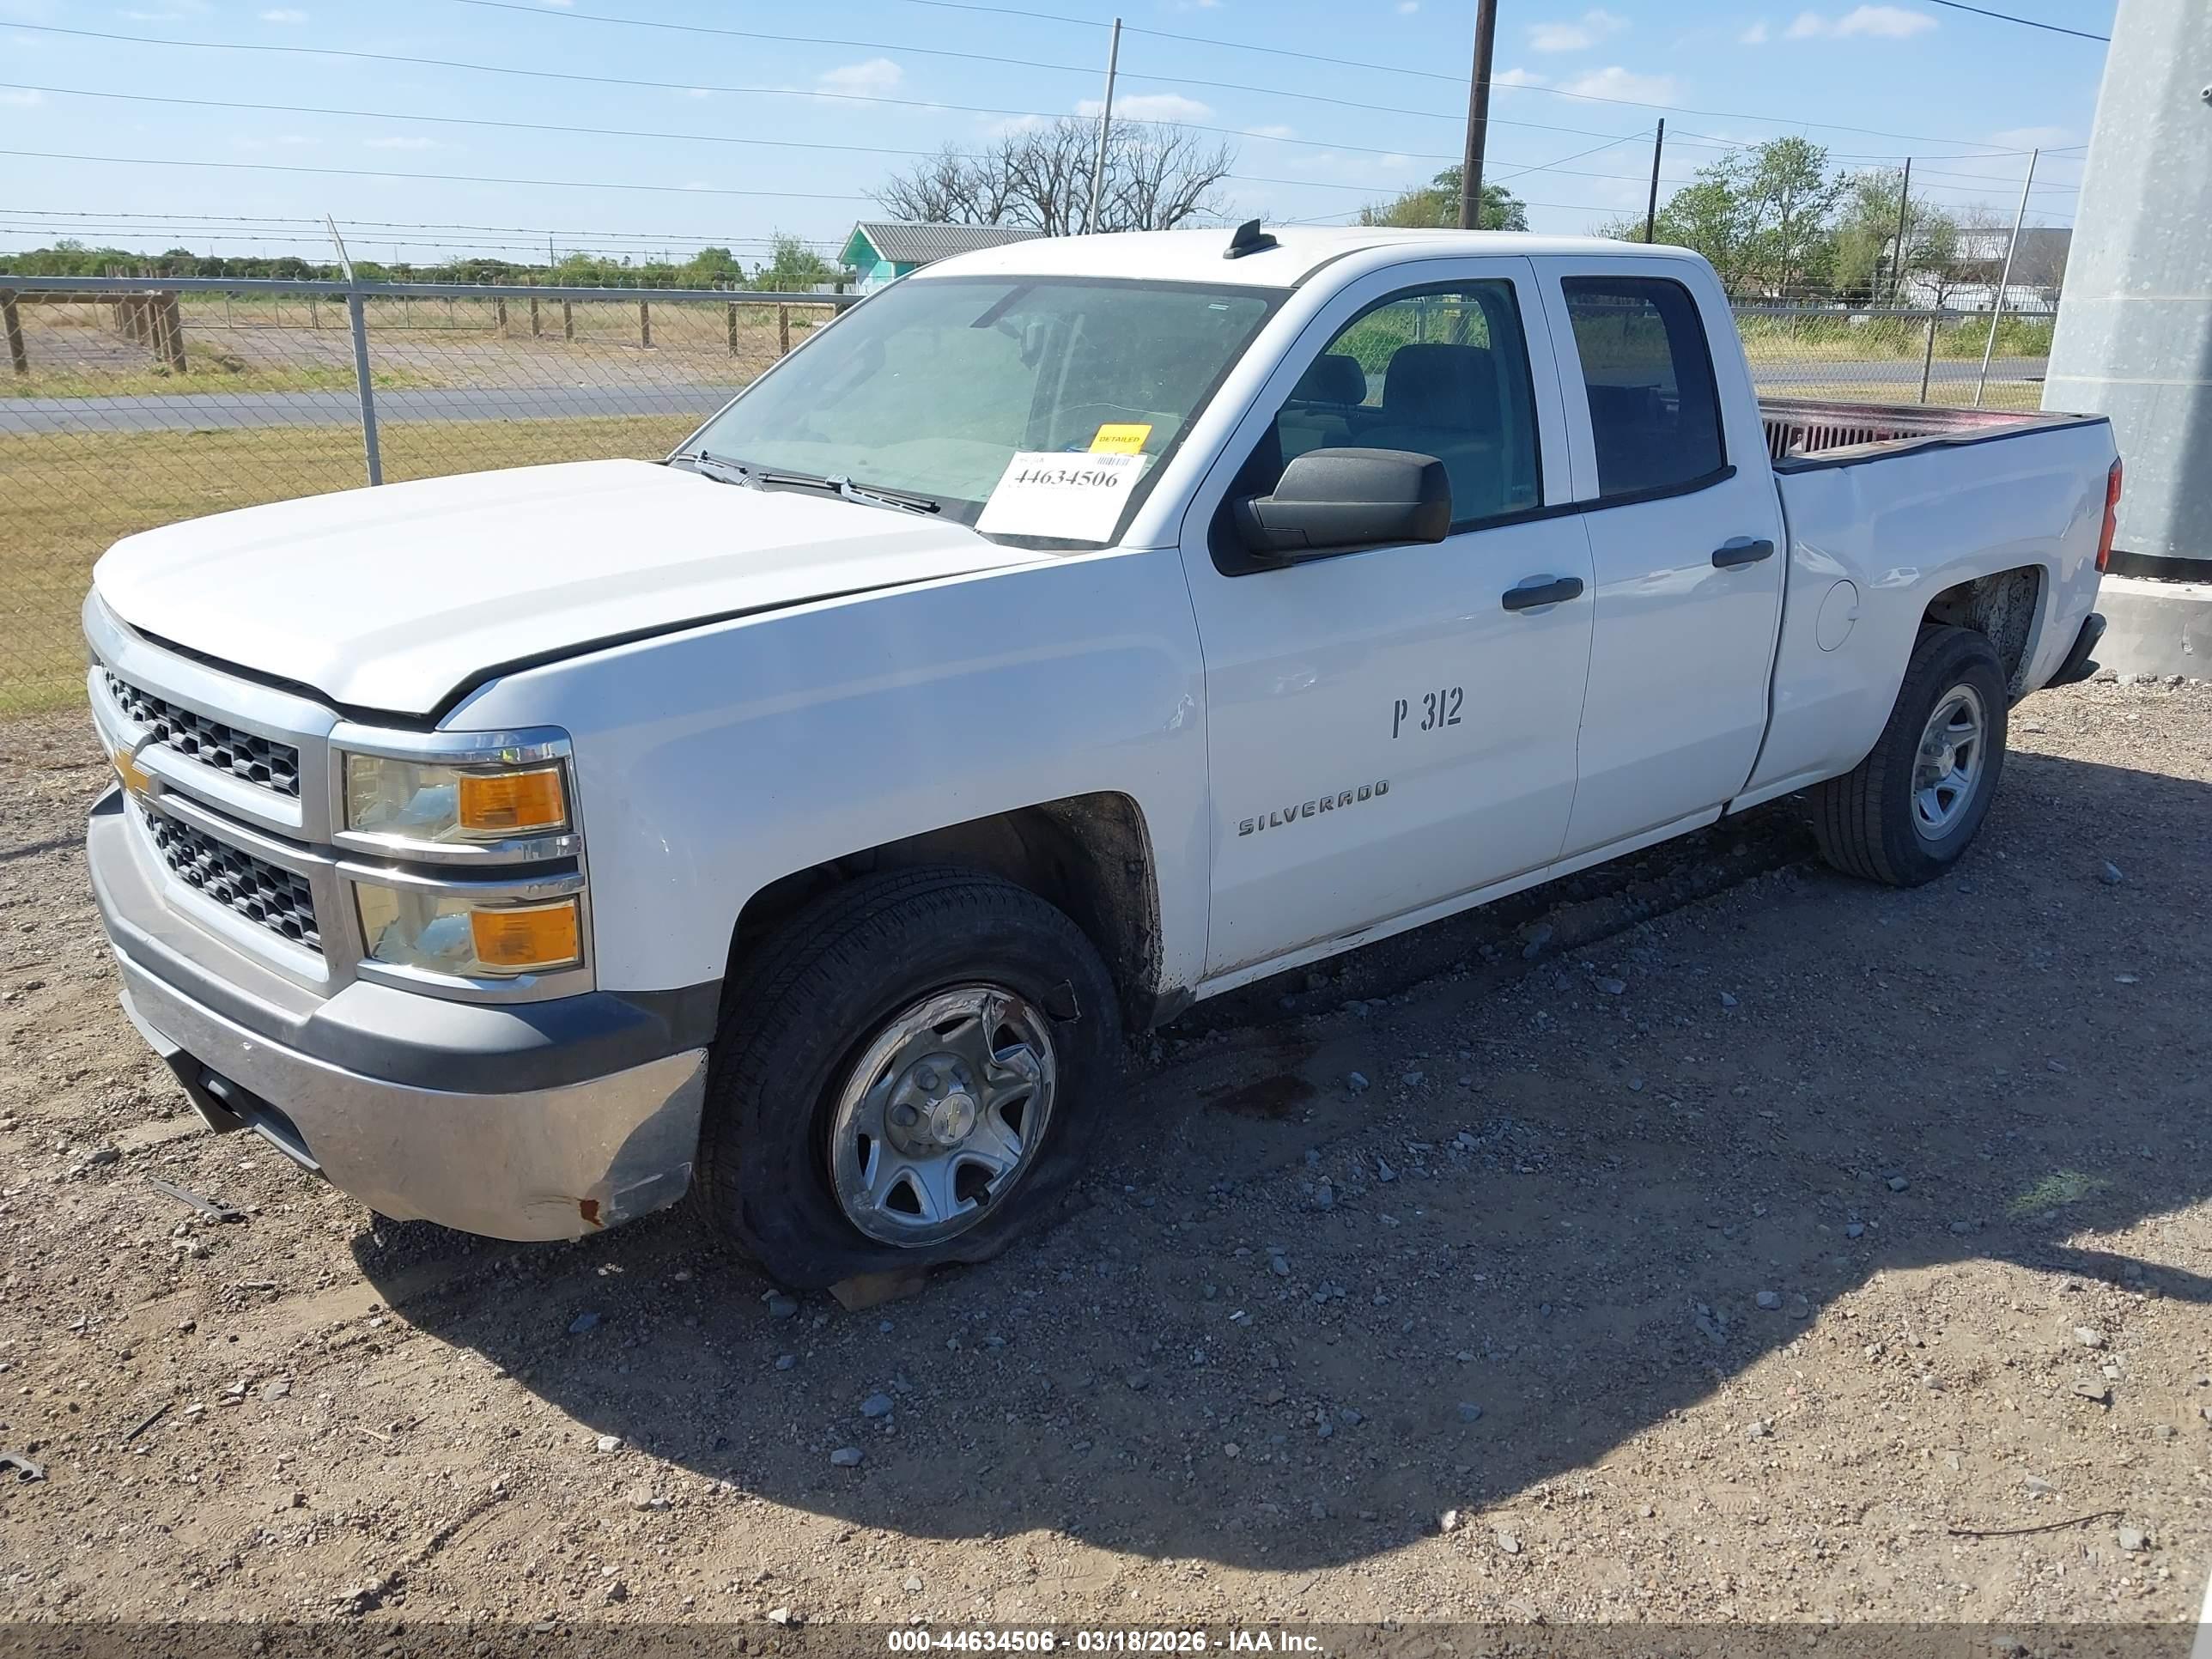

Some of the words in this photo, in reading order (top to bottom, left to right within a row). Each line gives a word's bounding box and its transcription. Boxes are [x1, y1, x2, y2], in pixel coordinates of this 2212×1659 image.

[1015, 469, 1120, 488] 44634506
[1393, 699, 1407, 738] P
[1421, 686, 1464, 731] 312
[1238, 779, 1390, 836] SILVERADO
